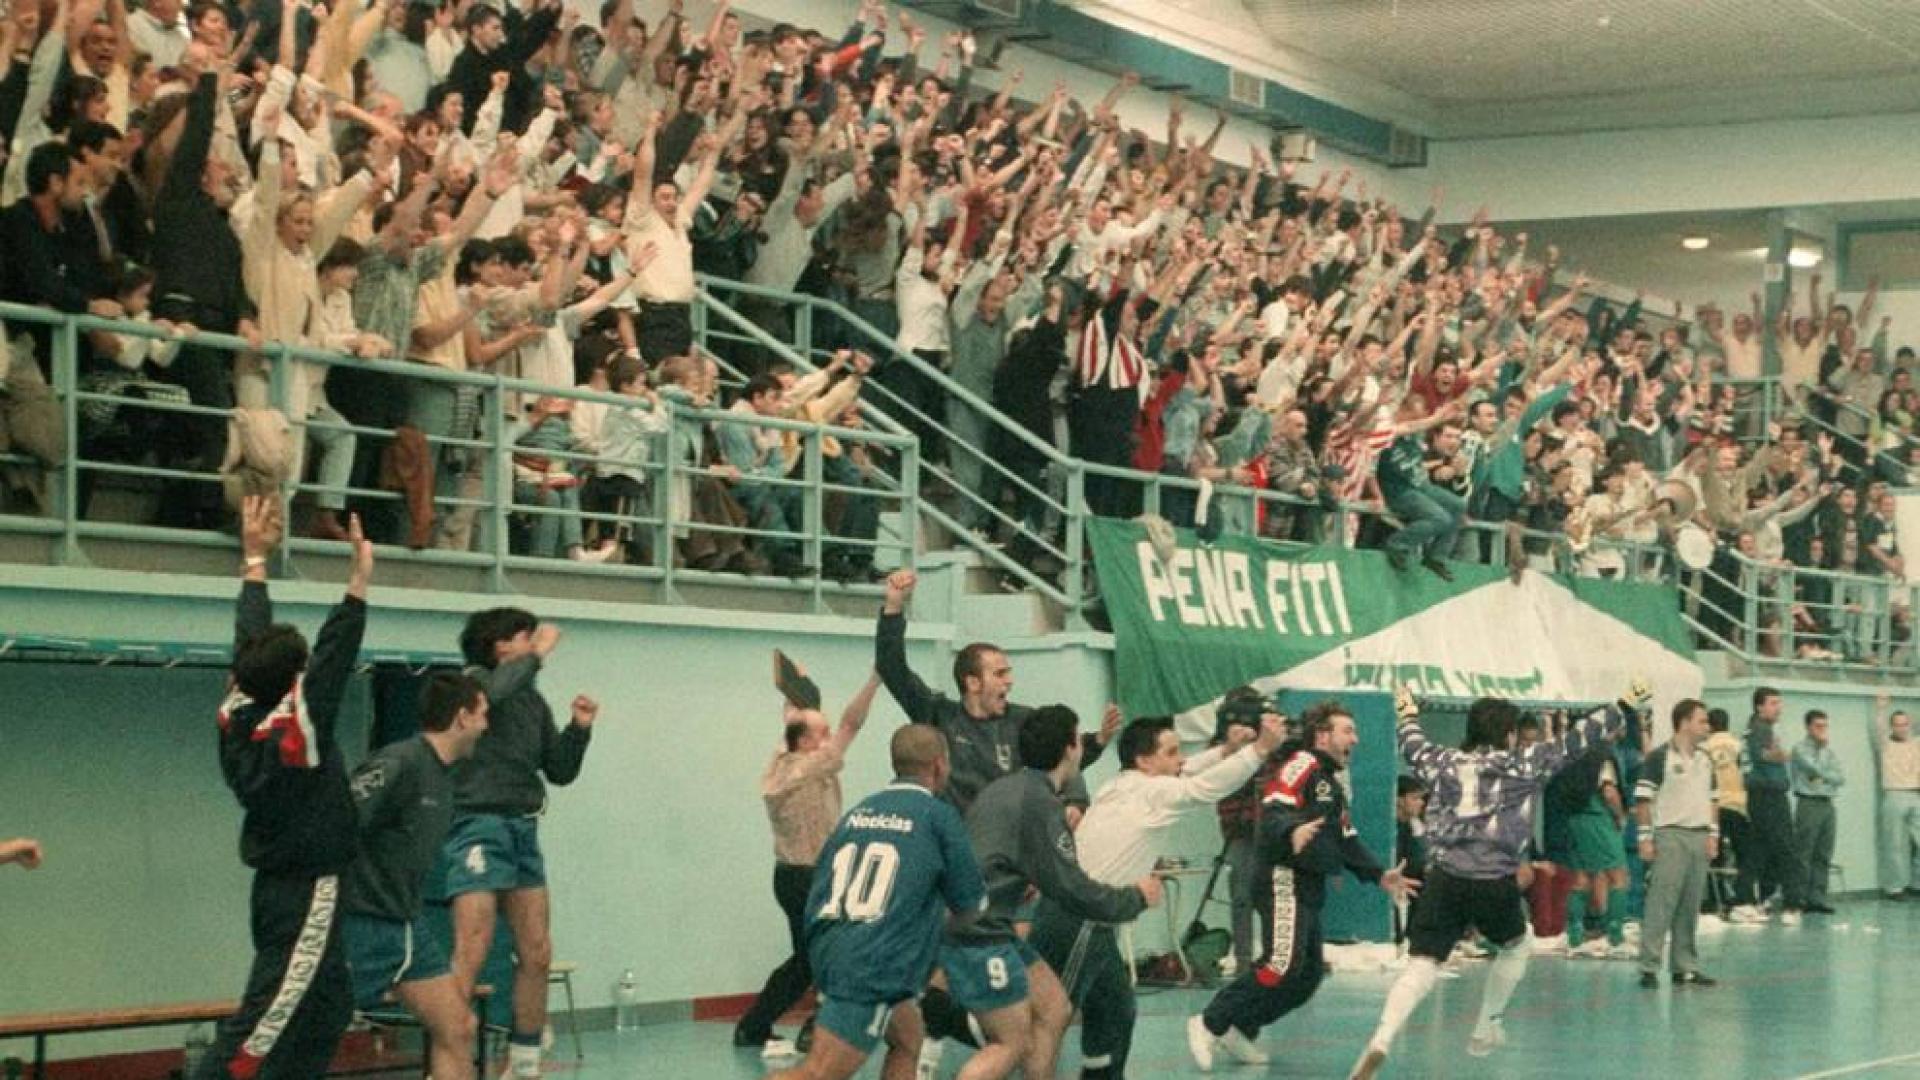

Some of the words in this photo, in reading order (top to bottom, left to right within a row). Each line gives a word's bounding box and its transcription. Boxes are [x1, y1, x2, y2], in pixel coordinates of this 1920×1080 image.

[1266, 559, 1352, 636] FITI
[816, 842, 900, 923] 10
[987, 957, 1008, 989] 9
